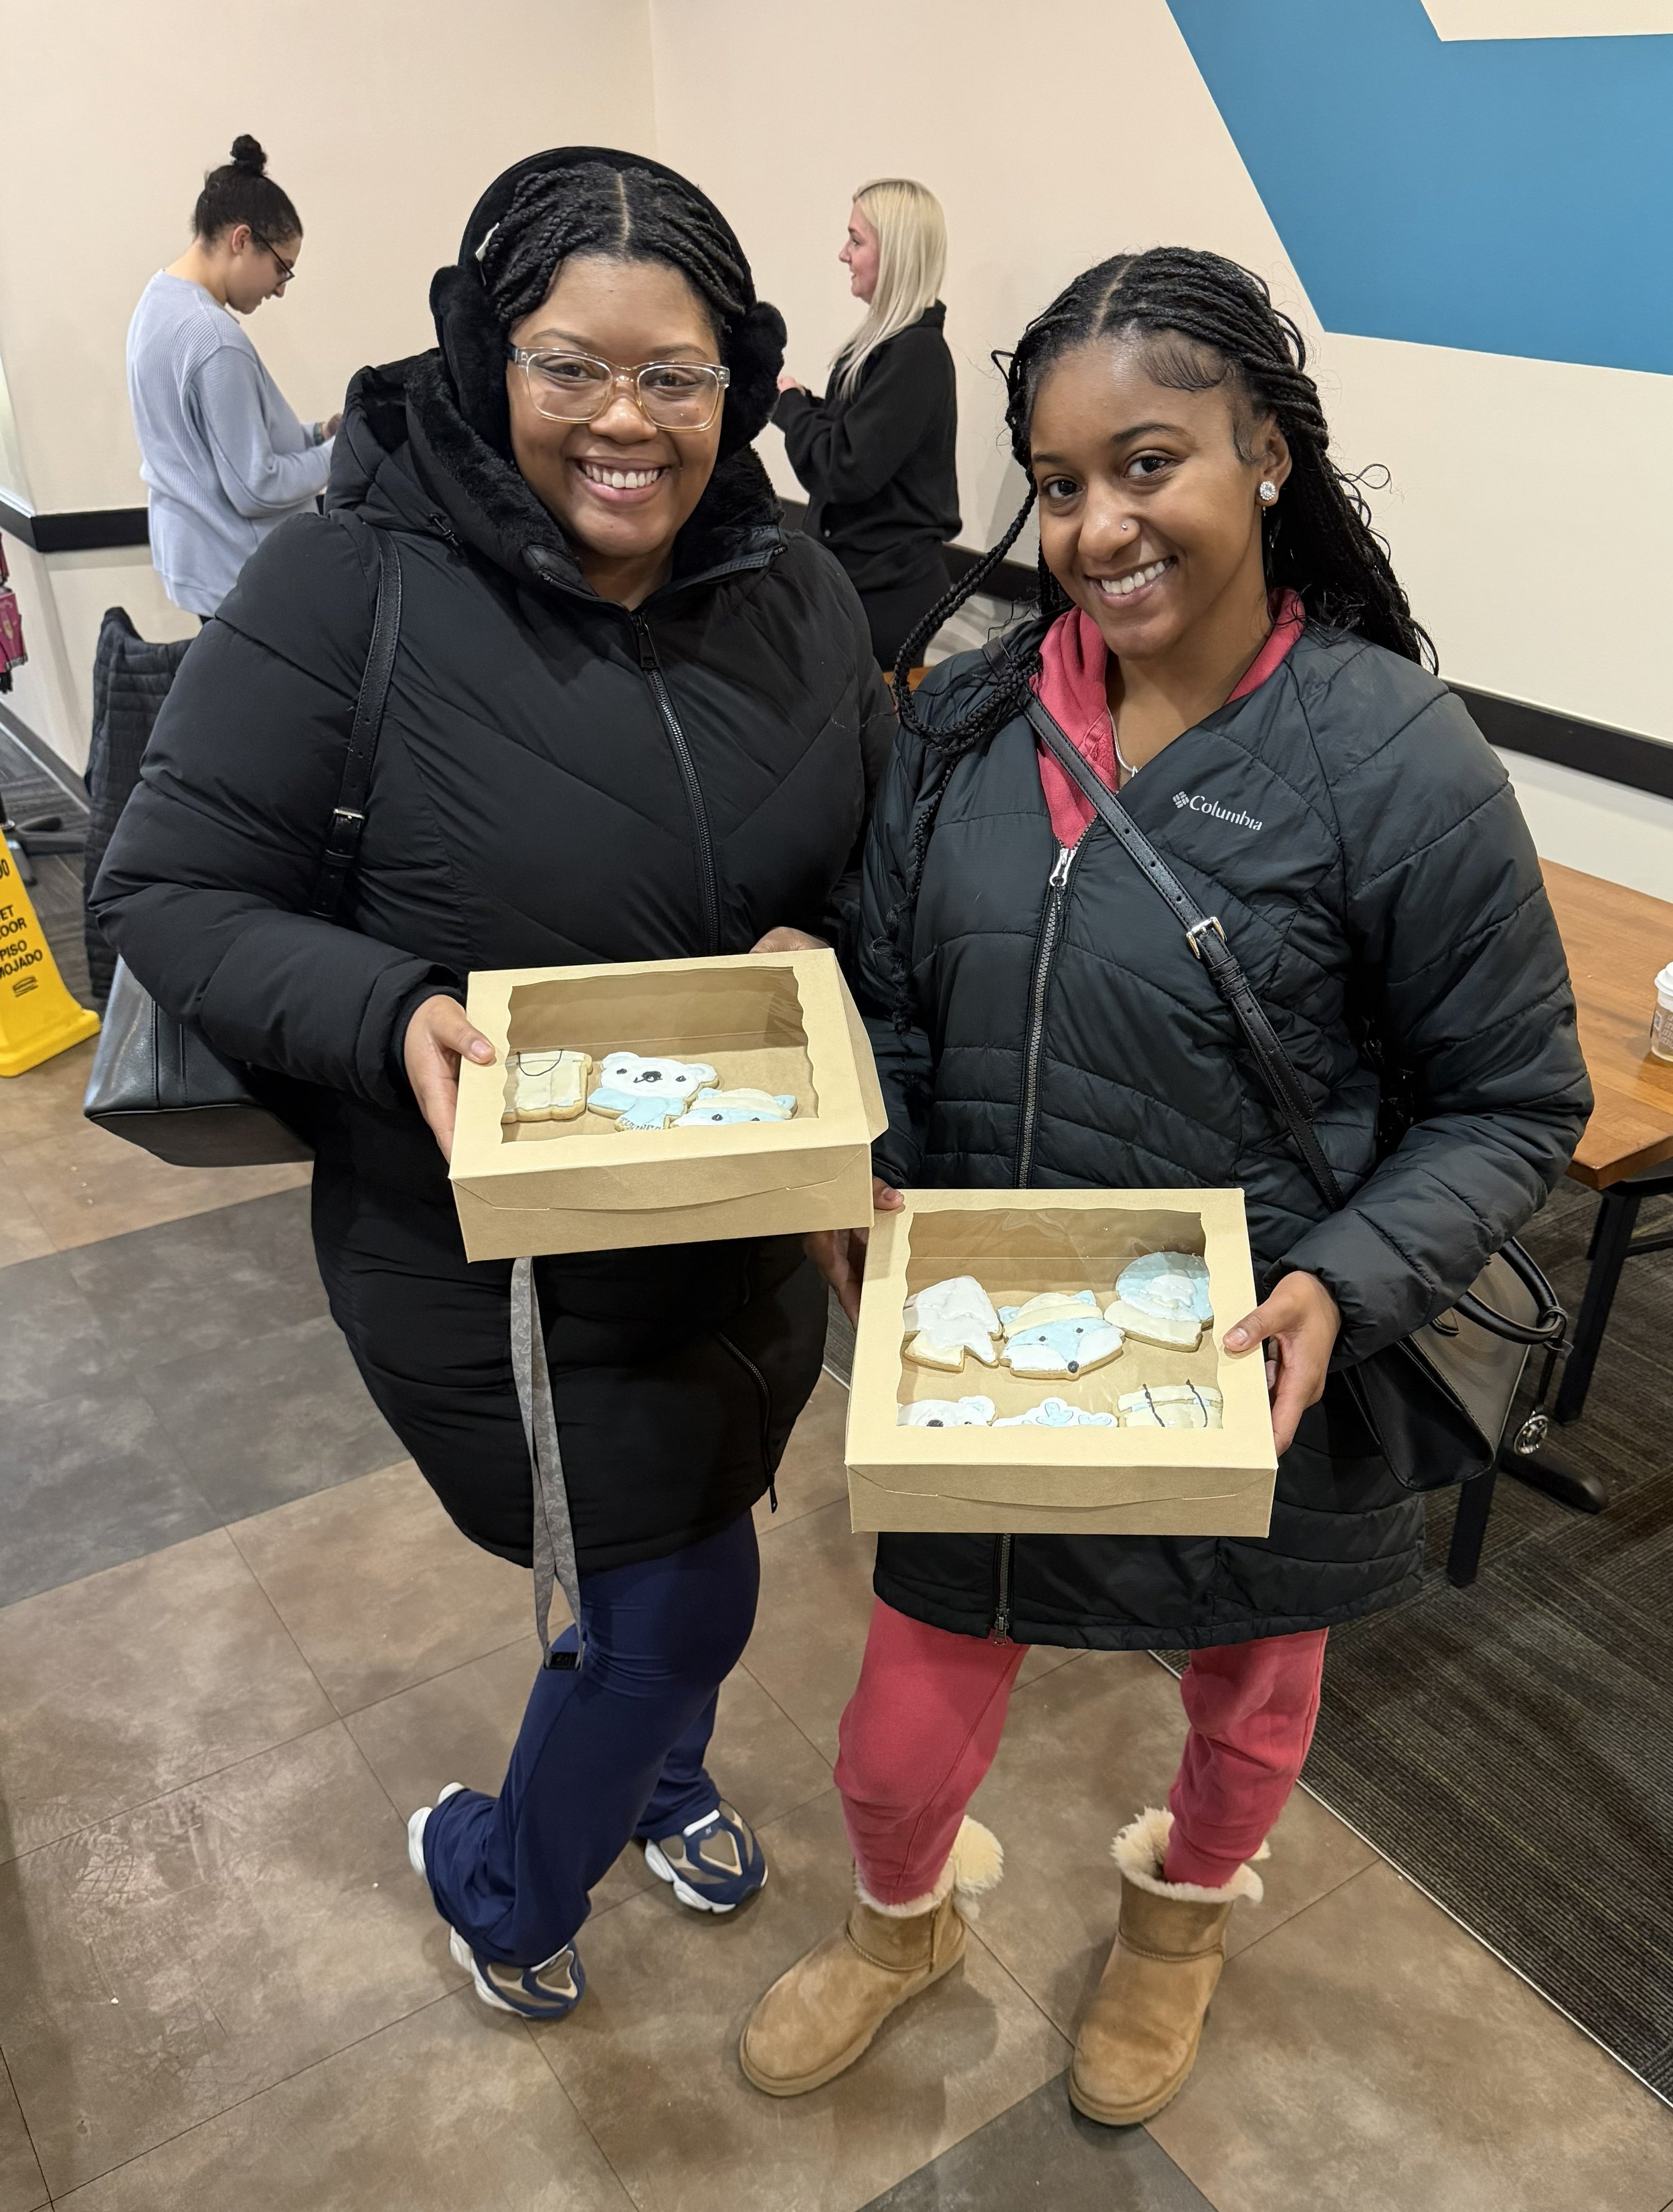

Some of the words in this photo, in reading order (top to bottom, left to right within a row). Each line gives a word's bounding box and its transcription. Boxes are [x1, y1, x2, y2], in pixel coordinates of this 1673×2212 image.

[1189, 795, 1263, 831] Columbia
[0, 904, 13, 921] ET
[0, 917, 27, 940] OOR
[0, 940, 27, 961] PISO
